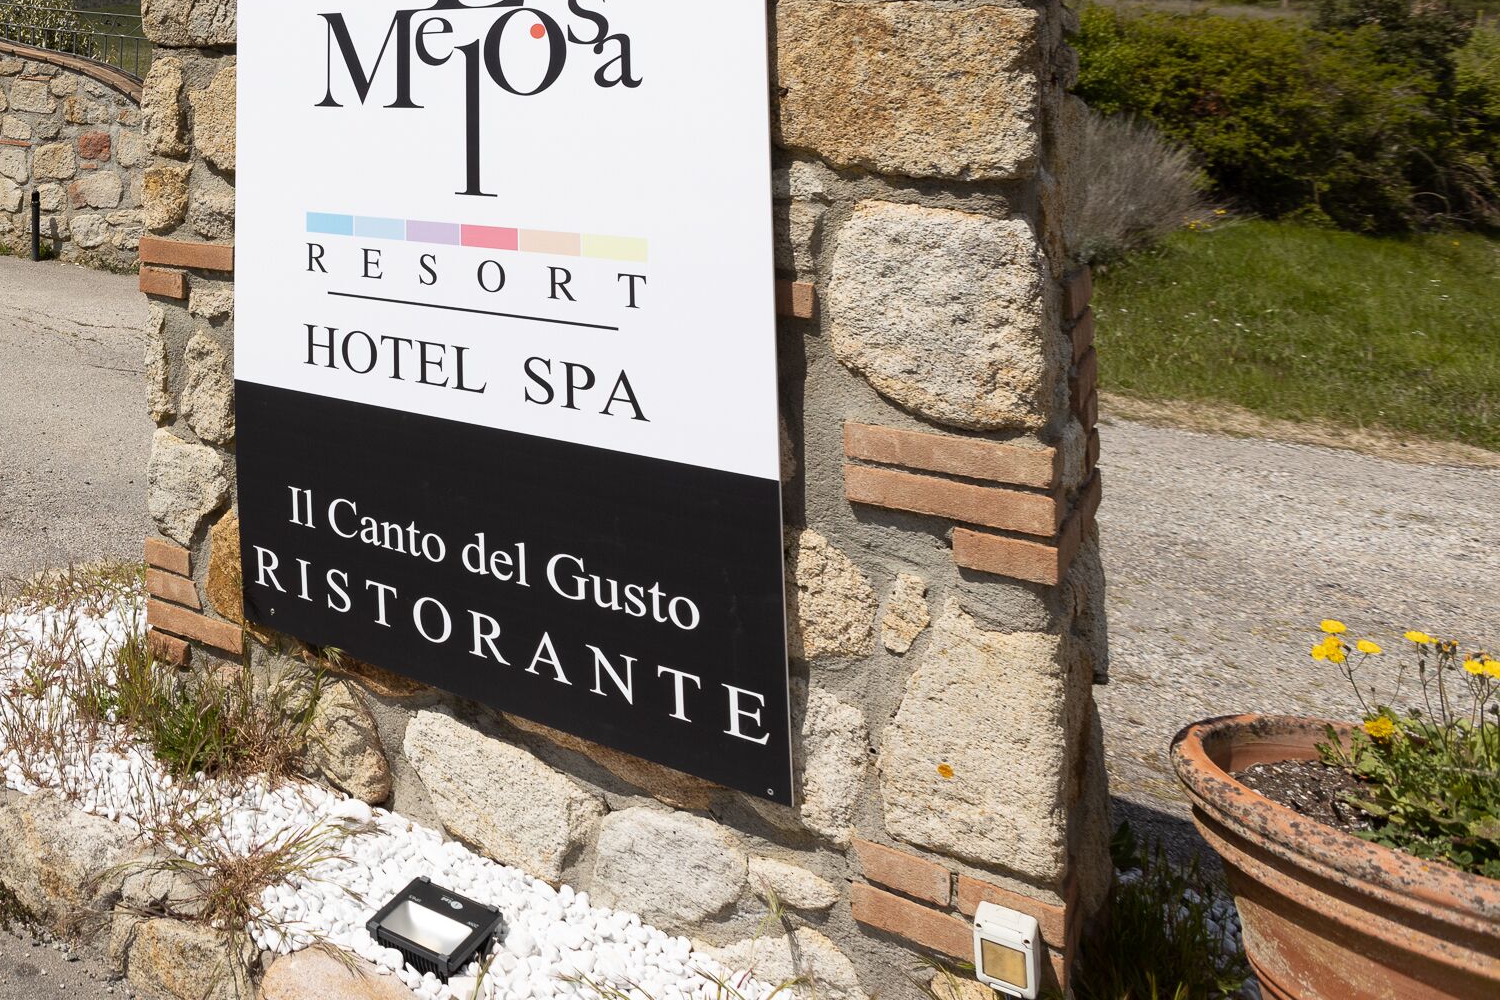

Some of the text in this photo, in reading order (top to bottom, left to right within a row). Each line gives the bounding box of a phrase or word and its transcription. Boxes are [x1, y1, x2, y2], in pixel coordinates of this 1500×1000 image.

[305, 242, 647, 309] RESORT
[303, 323, 651, 423] HOTEL SPA
[287, 485, 700, 631] Il Canto del Gusto
[252, 544, 771, 746] RISTORANTE
